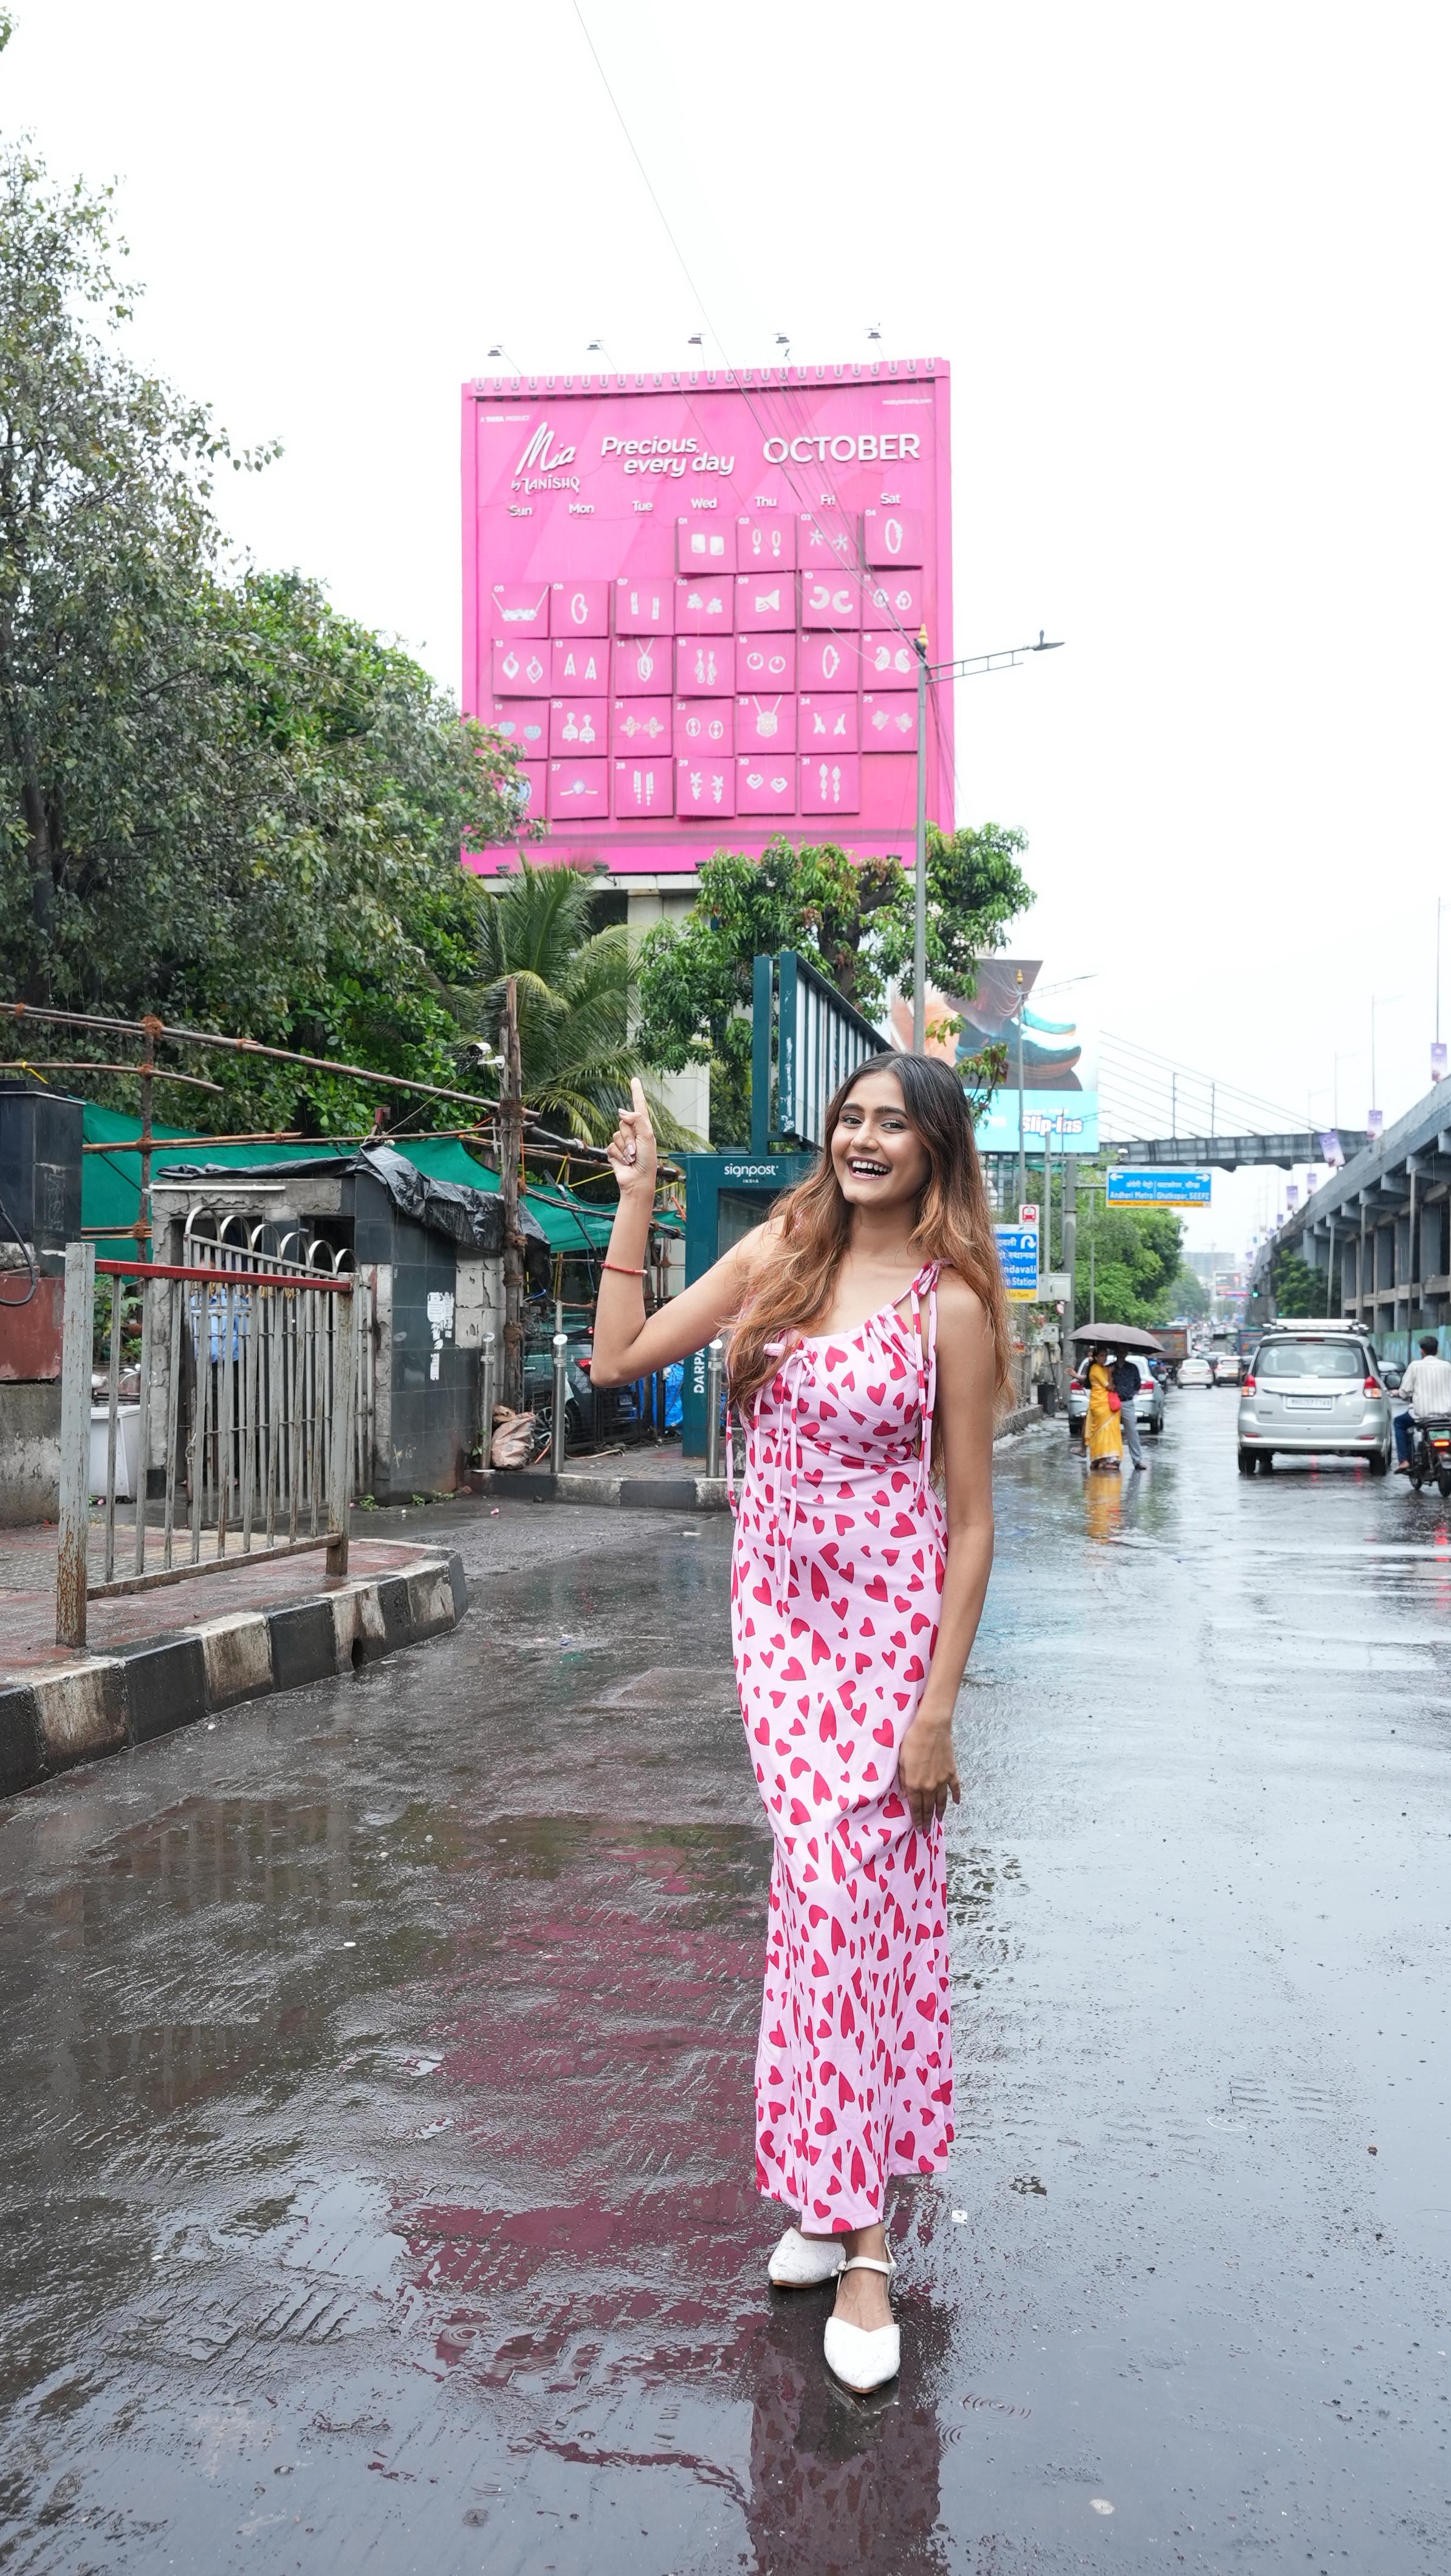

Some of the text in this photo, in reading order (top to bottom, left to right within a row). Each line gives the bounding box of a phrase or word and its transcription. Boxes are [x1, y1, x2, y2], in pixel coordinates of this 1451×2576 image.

[515, 422, 575, 476] Mia
[763, 434, 920, 464] OCTOBER
[623, 452, 735, 478] every day
[511, 480, 521, 491] by
[509, 493, 900, 516] Sun Mon Tue Wed Thu Fri Sat
[863, 634, 872, 642] 18
[552, 701, 563, 709] 20
[551, 763, 561, 772] 27
[724, 1163, 777, 1177] signpost
[1004, 1265, 1036, 1273] ndavali
[1012, 1277, 1036, 1286] Station
